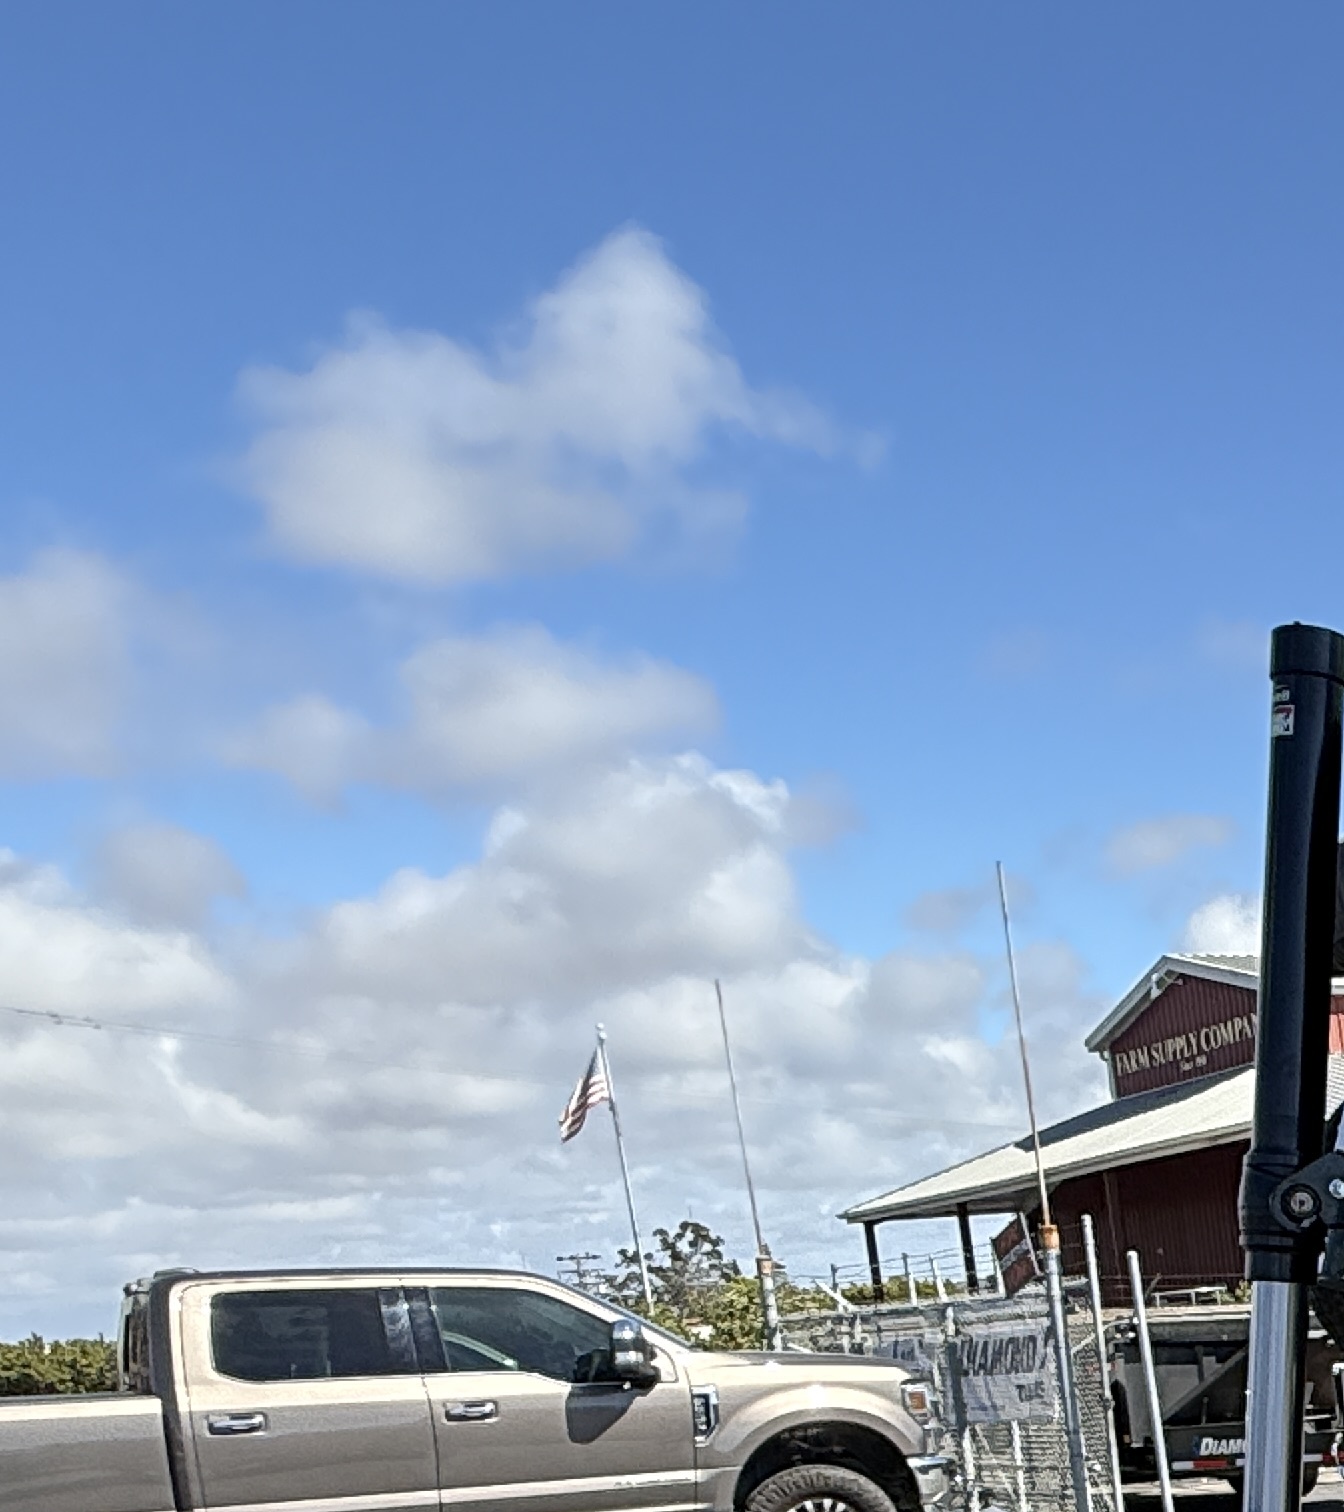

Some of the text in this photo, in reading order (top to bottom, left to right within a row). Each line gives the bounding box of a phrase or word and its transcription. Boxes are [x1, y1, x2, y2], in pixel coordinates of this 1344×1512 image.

[1115, 1012, 1258, 1077] FARM SUPPLY COMPAN
[1200, 1437, 1246, 1456] DIAM
